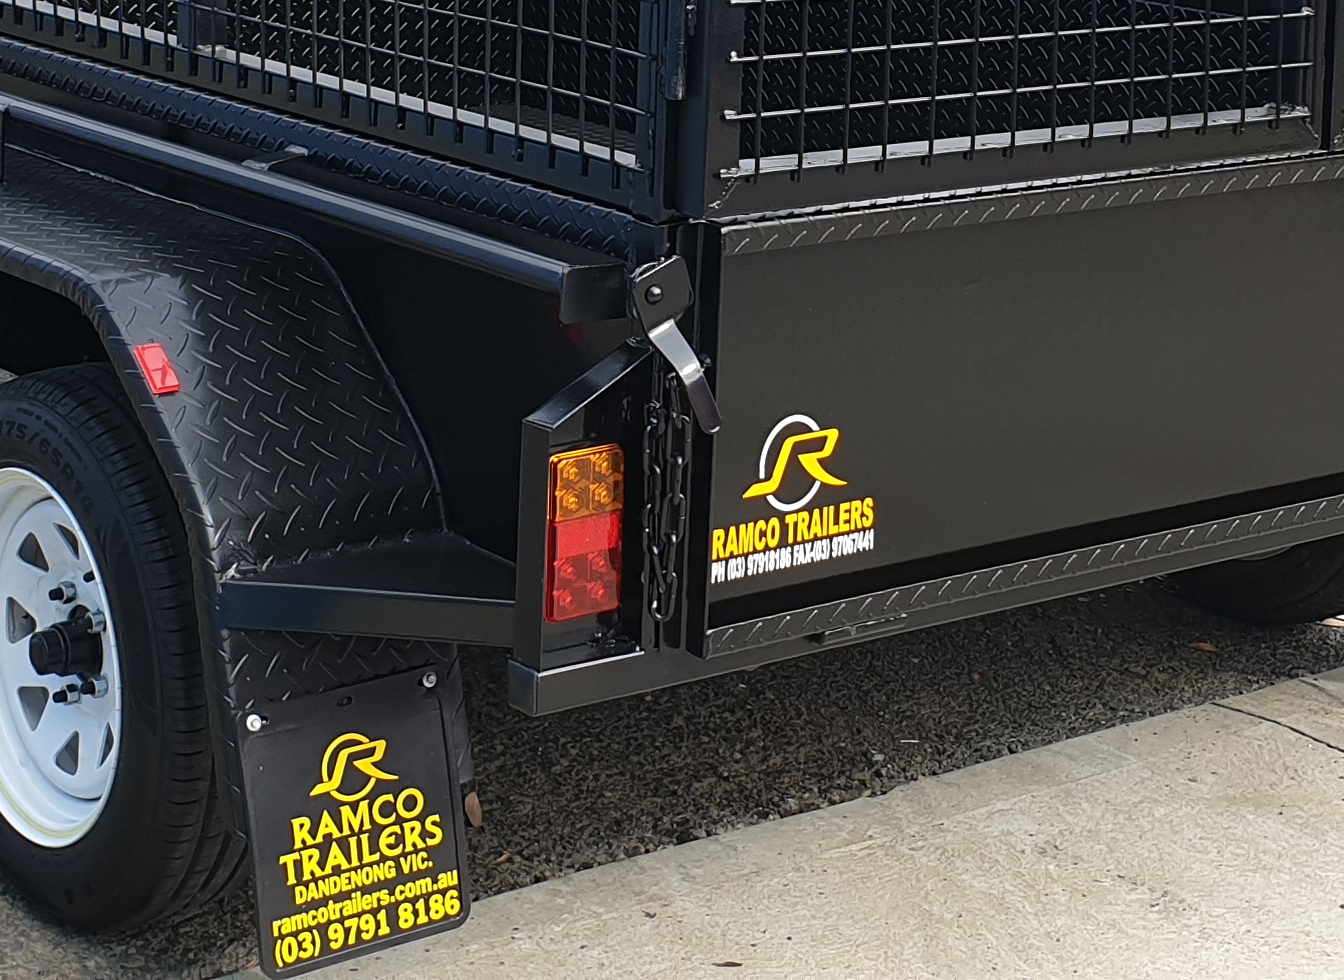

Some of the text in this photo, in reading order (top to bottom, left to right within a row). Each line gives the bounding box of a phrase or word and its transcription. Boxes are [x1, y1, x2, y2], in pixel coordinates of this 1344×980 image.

[711, 497, 875, 561] RAMCO TRAILERS
[711, 560, 726, 584] PH
[727, 557, 746, 581] (03)
[747, 547, 792, 576] 97918186
[831, 528, 875, 558] 97067441
[278, 814, 443, 886] TRAILERS
[290, 787, 425, 850] RAMCO
[272, 870, 459, 937] ramcotrailers.com.au
[294, 851, 434, 905] DANDENONG VIC.
[274, 890, 460, 968] (03) 9791 8186
